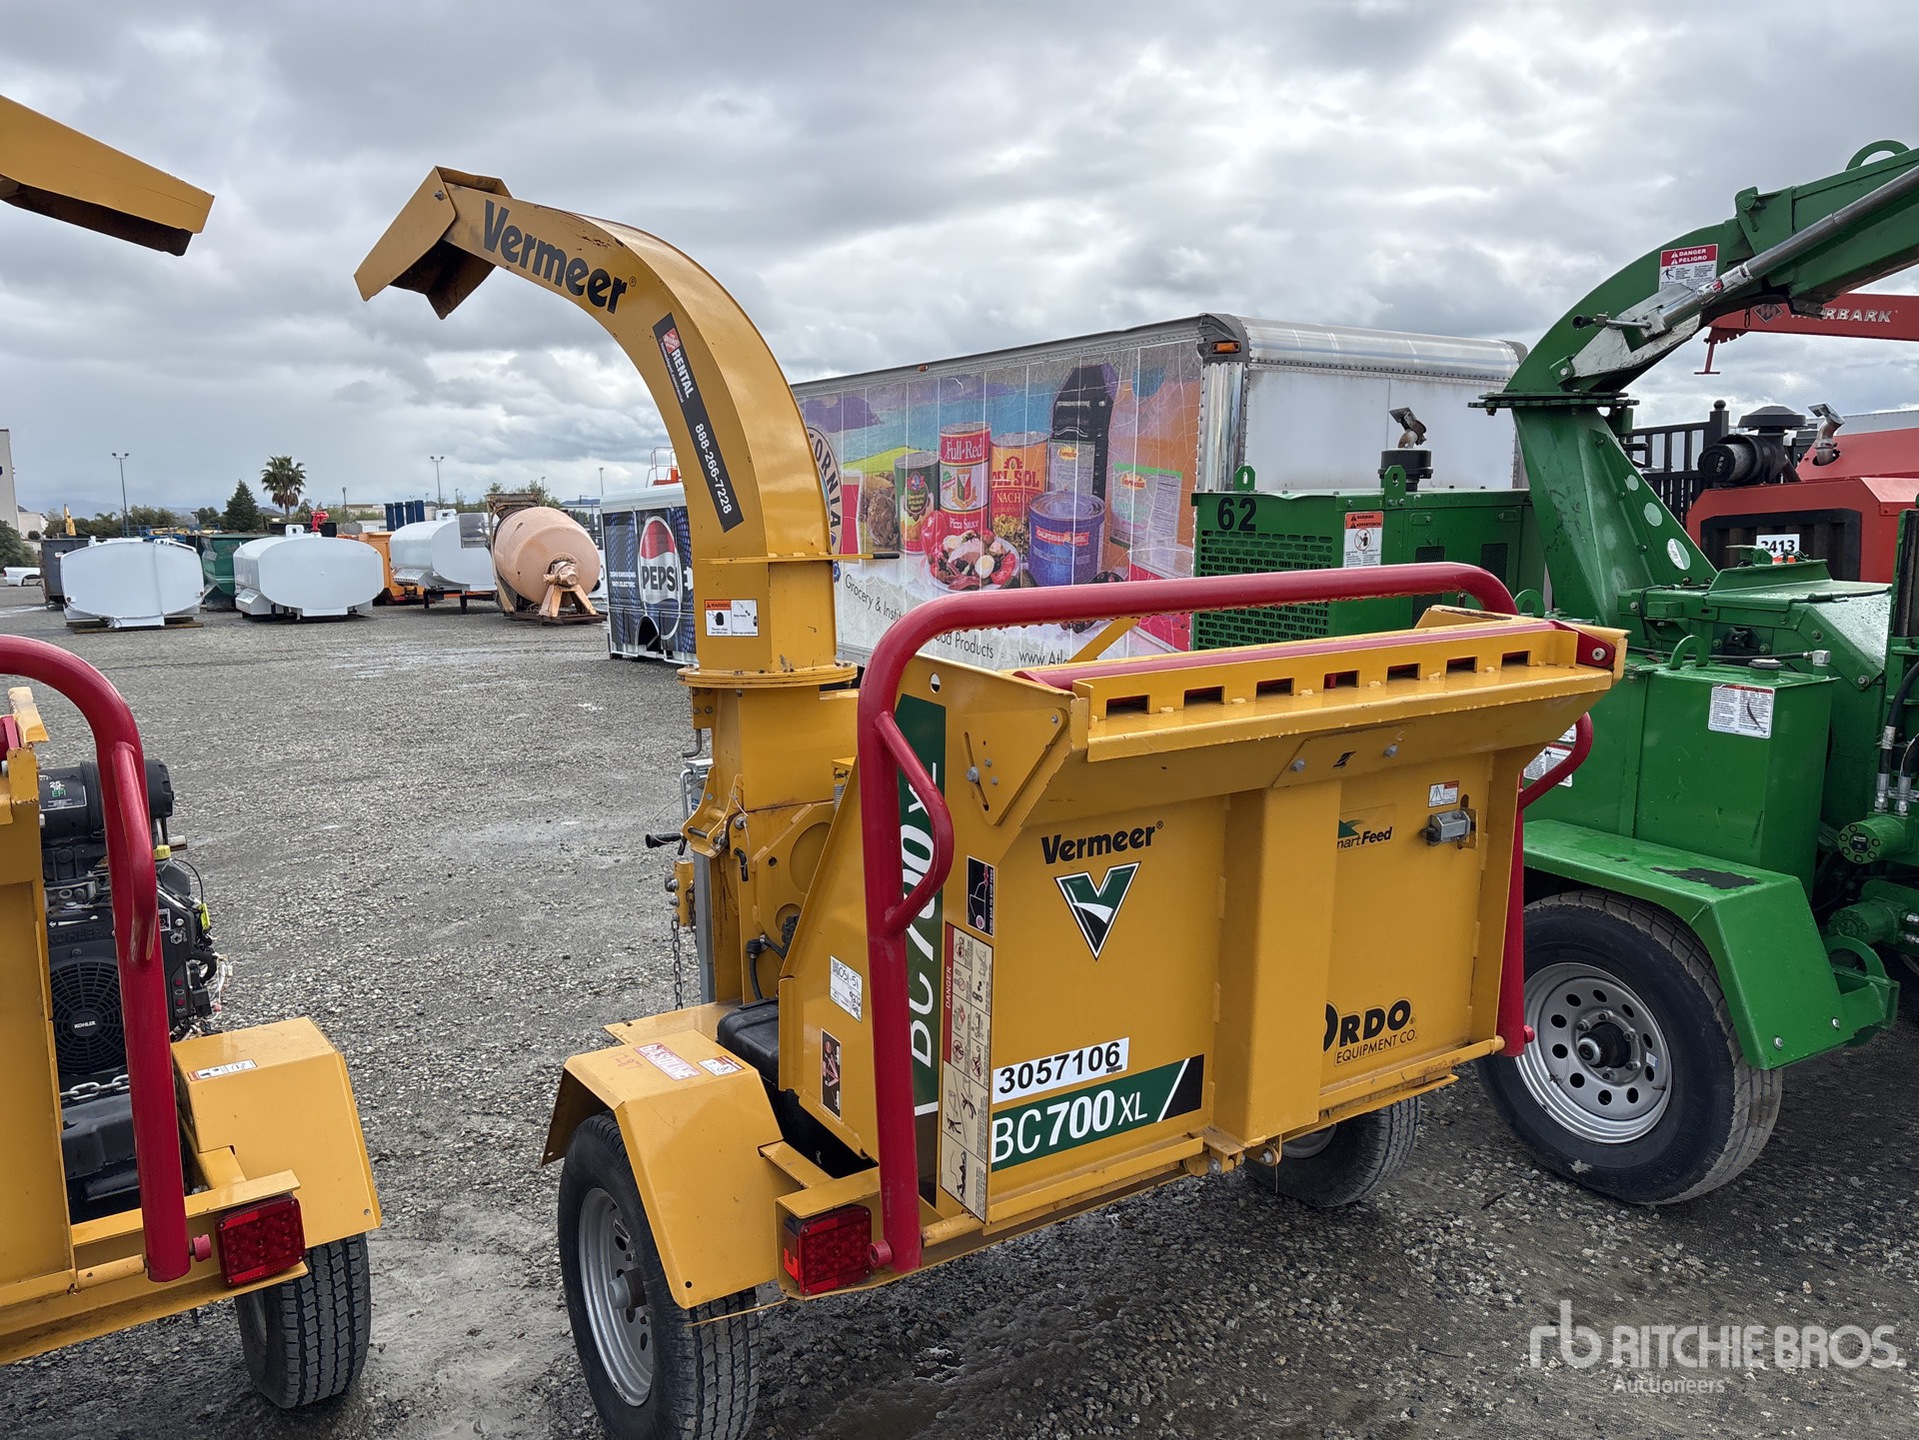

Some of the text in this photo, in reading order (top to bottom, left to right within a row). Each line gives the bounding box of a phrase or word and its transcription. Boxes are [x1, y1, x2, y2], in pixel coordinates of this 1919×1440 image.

[483, 199, 628, 315] Vermeer
[1678, 248, 1706, 257] DANGER
[1678, 255, 1707, 263] PELIGRO
[671, 349, 695, 398] RENTAL
[695, 423, 732, 514] 888-266-7228
[991, 471, 1040, 487] DEL SOL
[1217, 497, 1257, 532] 62
[642, 566, 678, 592] PEPSI
[845, 574, 874, 610] Grocery
[875, 597, 882, 613] &
[955, 632, 994, 659] Products
[1041, 826, 1155, 864] Vermeer
[74, 1020, 96, 1028] KOHLER
[1336, 1029, 1418, 1064] EQUIPMENT CO.
[998, 1042, 1120, 1094] 3057106
